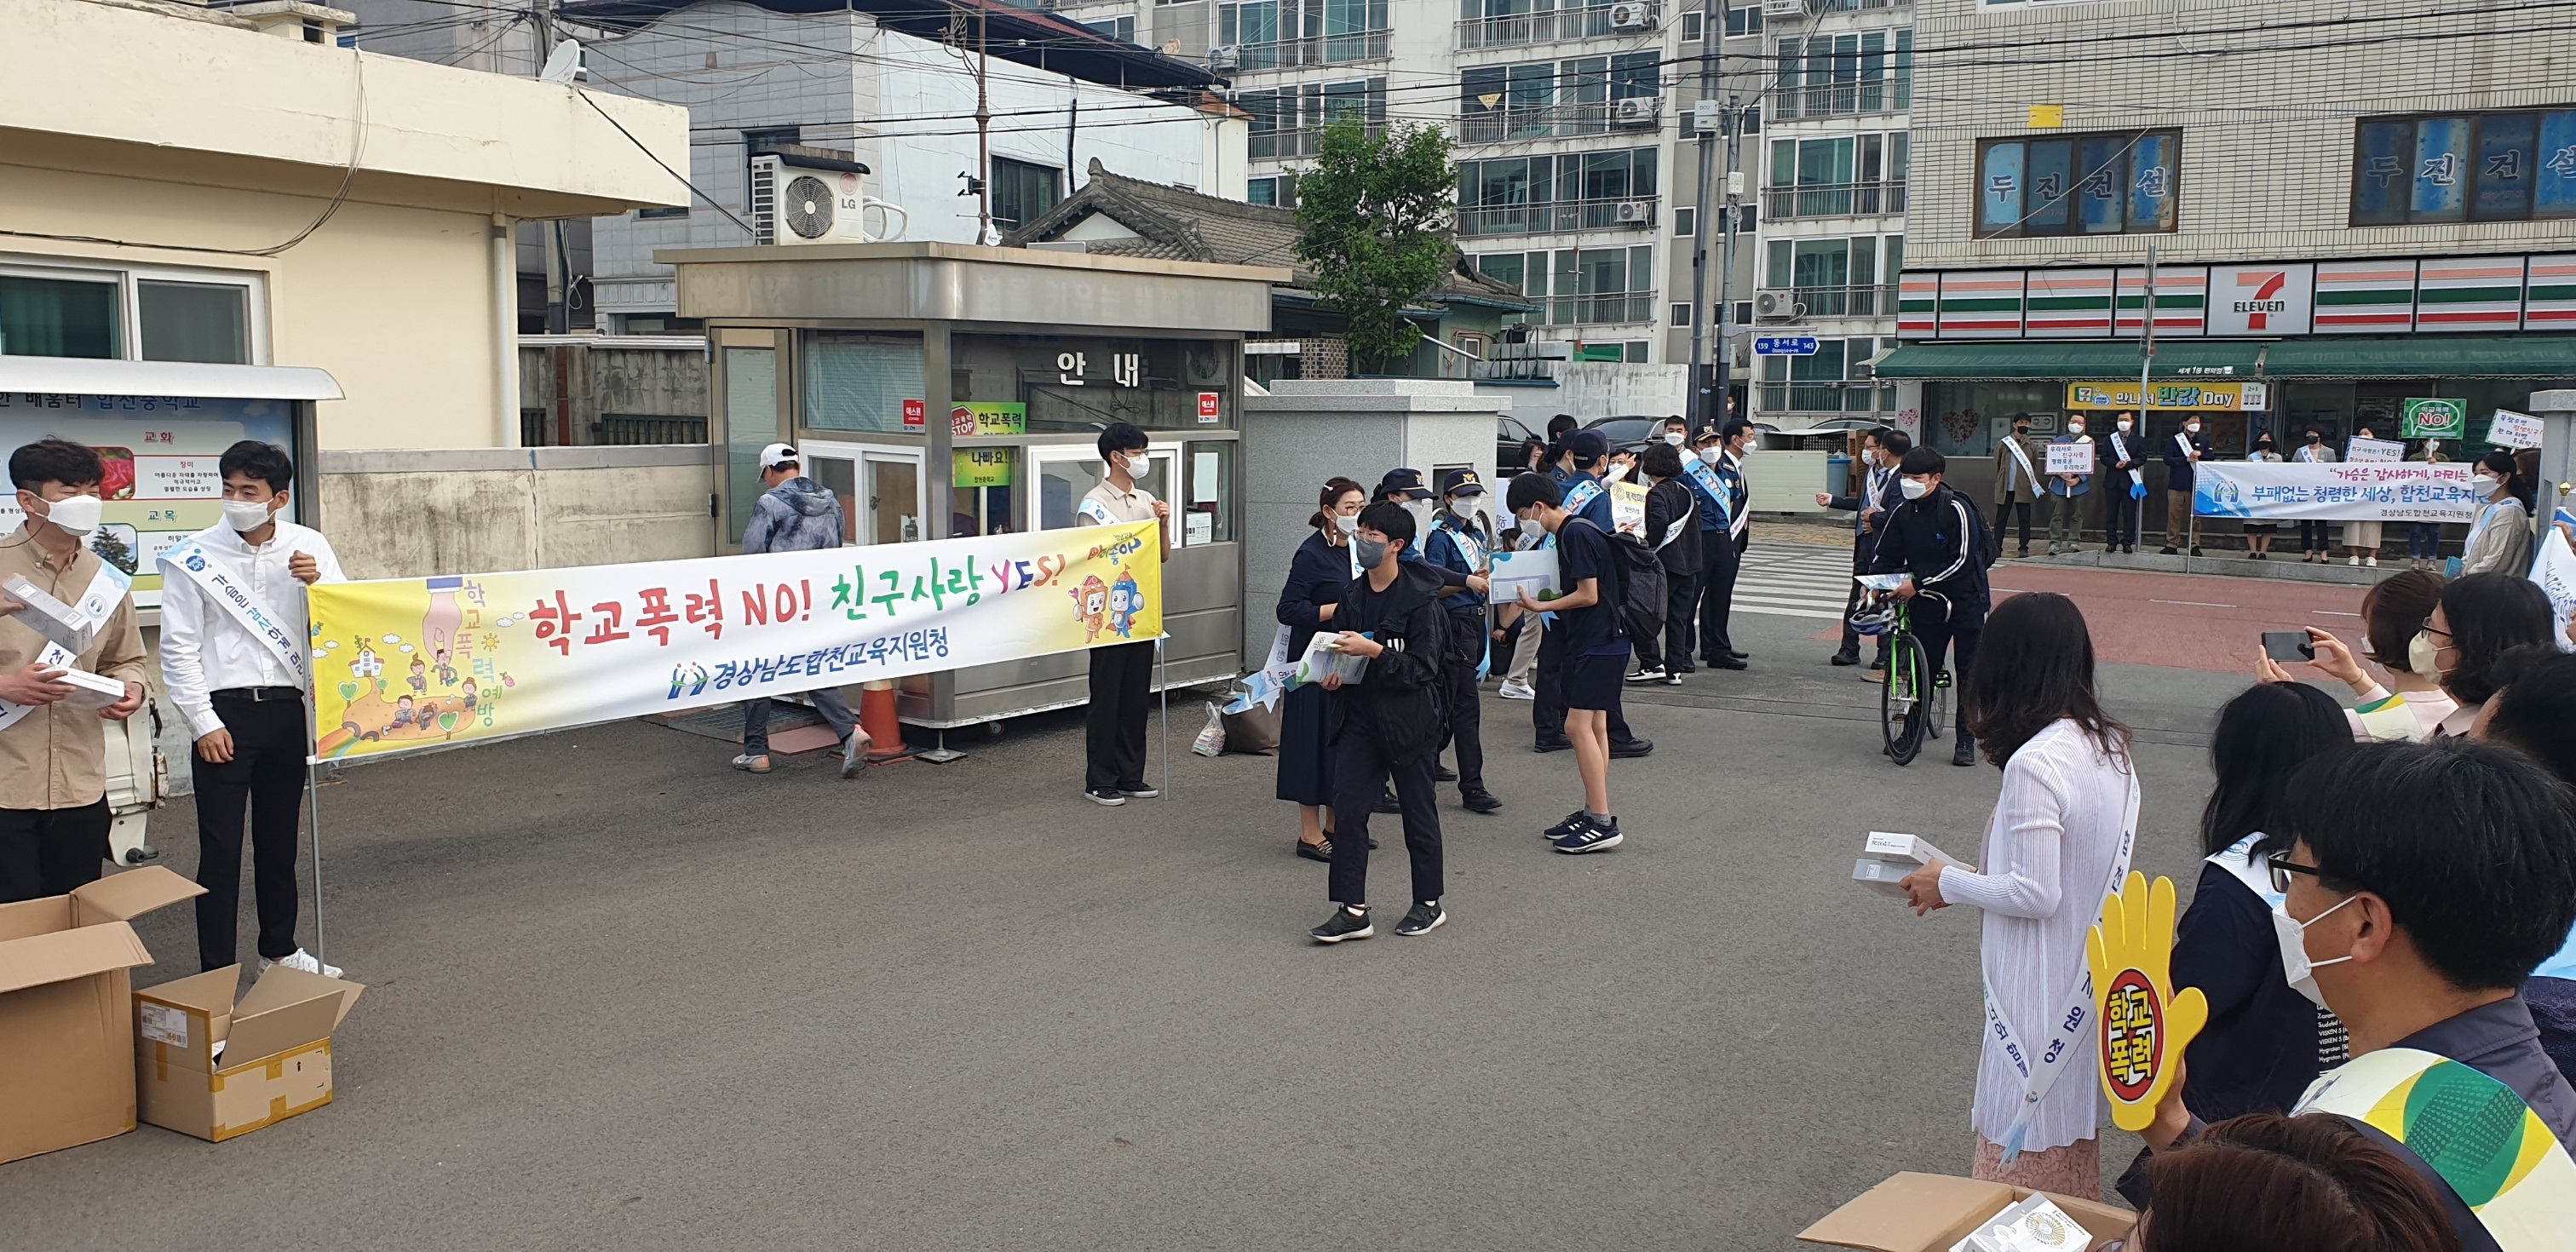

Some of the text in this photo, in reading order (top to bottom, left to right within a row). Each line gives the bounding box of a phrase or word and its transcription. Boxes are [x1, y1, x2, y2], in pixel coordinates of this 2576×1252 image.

[1987, 166, 2166, 203] 두진건설
[841, 198, 856, 210] LG
[2234, 300, 2285, 313] ELEVEN
[1773, 338, 1798, 347] 동서로
[2157, 386, 2199, 407] 반값
[2203, 391, 2234, 407] Day
[978, 412, 1022, 428] 학교폭력
[2418, 412, 2450, 426] NO!
[971, 451, 1009, 467] 나빠요!
[2381, 447, 2401, 457] YES!
[2374, 468, 2430, 482] 감사하게,
[2434, 469, 2468, 483] 머리는
[2251, 485, 2310, 503] 부패없는
[2313, 485, 2358, 503] 청렴한
[2362, 485, 2396, 505] 세상,
[2380, 508, 2472, 520] 경상남도합천교육지원청
[529, 554, 1067, 657] 학교폭력 NO! 친구사랑 YES!
[712, 625, 950, 693] 경상남도합천교육지원청
[2109, 989, 2153, 1033] 학교
[2109, 1034, 2153, 1084] 폭력
